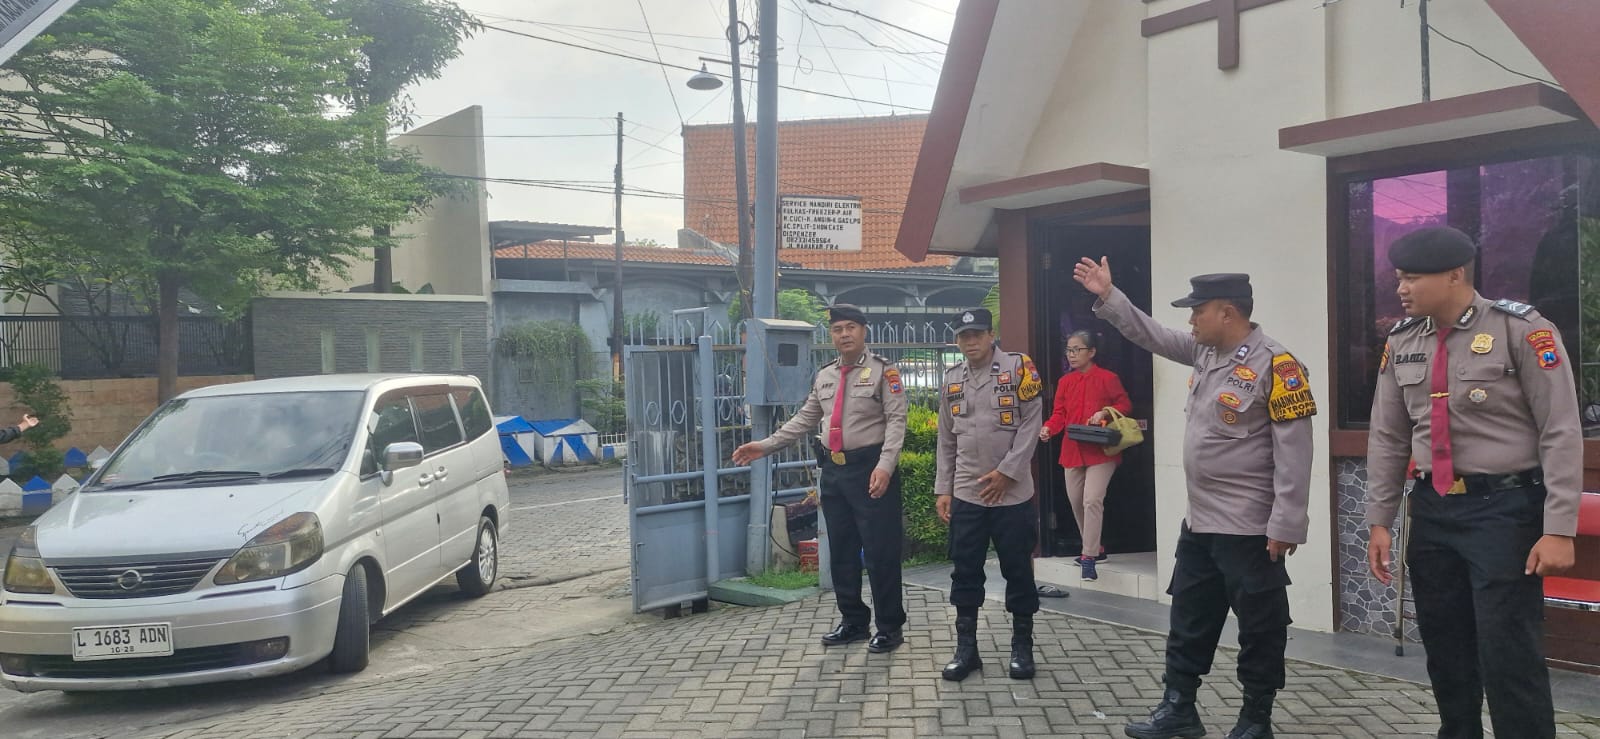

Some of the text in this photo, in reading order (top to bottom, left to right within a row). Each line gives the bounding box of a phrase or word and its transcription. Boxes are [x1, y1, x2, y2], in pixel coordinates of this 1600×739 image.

[993, 384, 1017, 394] POLRI
[1226, 377, 1255, 392] POLRI
[76, 627, 167, 647] L 1683 ADN
